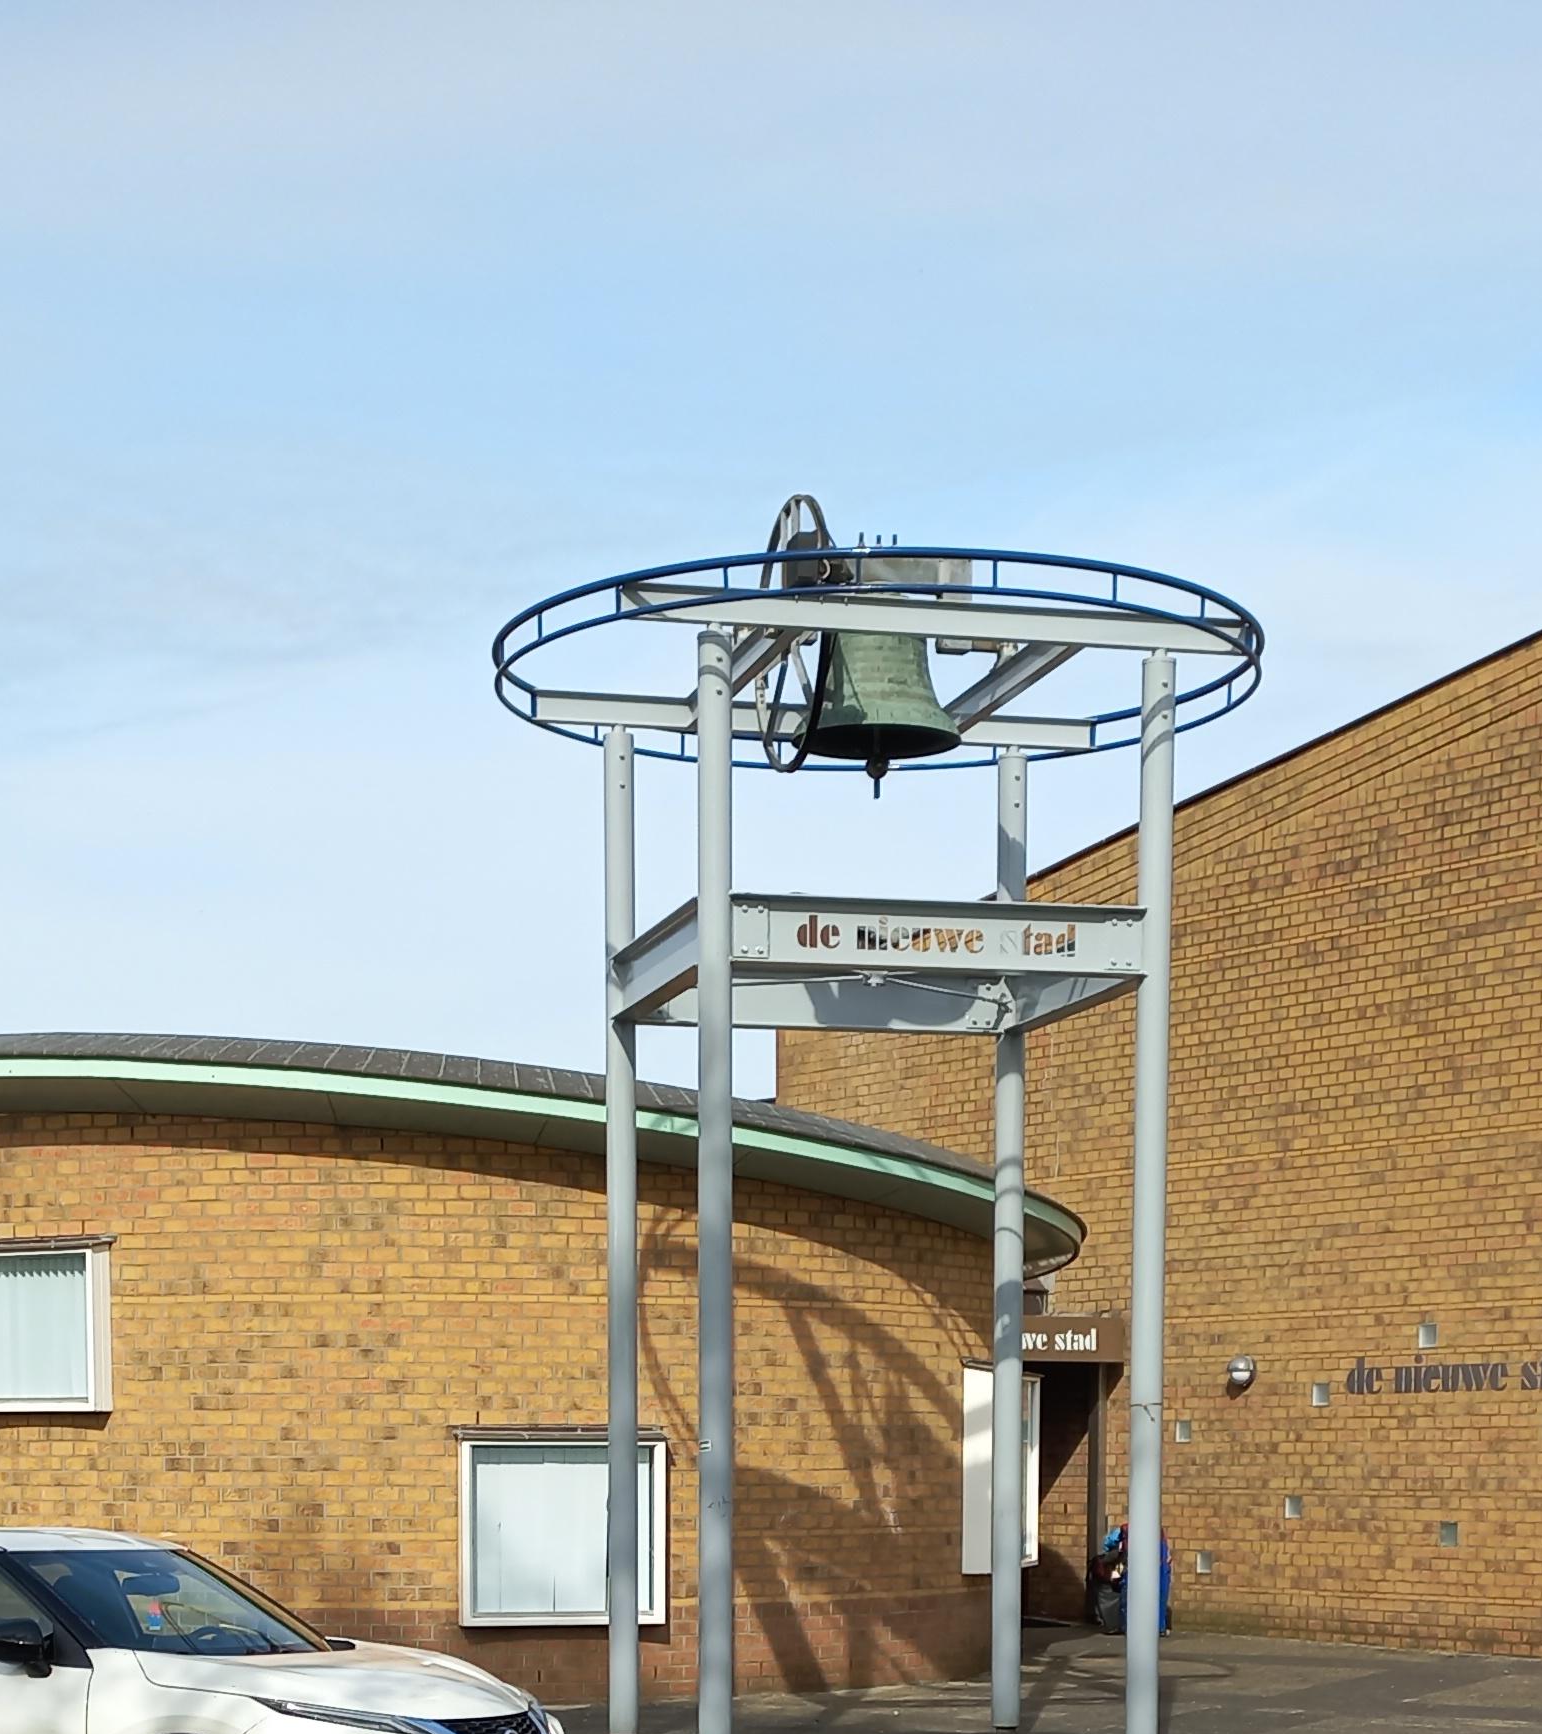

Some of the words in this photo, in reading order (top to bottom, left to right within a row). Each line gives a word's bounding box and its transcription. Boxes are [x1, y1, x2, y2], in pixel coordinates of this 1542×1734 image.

[796, 914, 841, 949] de
[856, 916, 985, 954] nieuwe
[999, 922, 1076, 958] stad
[1054, 1327, 1097, 1351] stad
[1346, 1355, 1383, 1395] de
[1394, 1353, 1508, 1394] nieuwe
